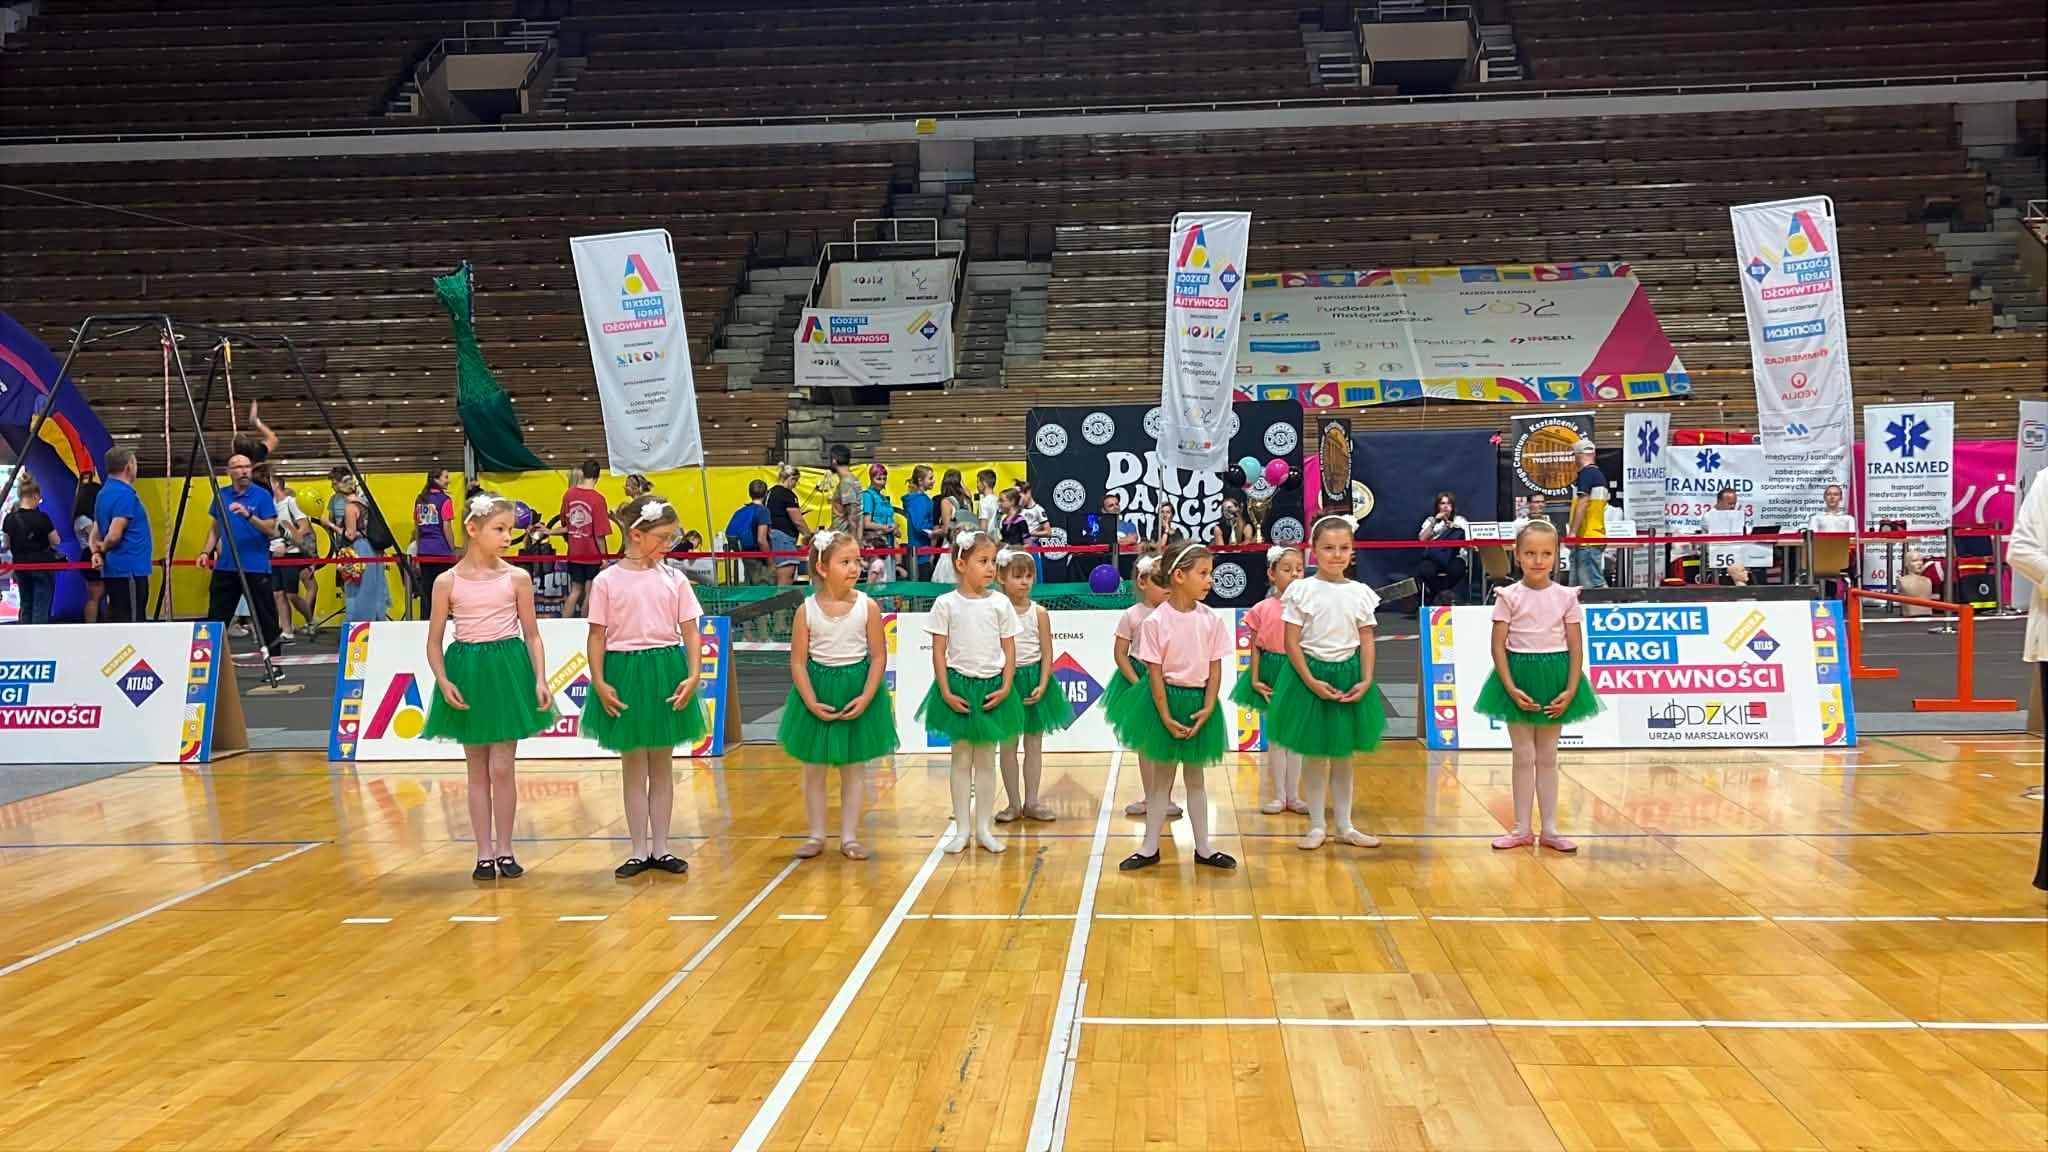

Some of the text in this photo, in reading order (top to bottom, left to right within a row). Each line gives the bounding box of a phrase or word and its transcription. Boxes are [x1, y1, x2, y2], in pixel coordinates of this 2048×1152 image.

[1867, 461, 1949, 474] TRANSMED
[1664, 478, 1753, 493] TRANSMED
[1891, 483, 1925, 492] transport
[1913, 490, 1947, 498] sanitarny
[1878, 504, 1937, 513] zabezpieczenia
[1716, 554, 1735, 567] 56
[1591, 607, 1703, 632] ŁÓDZKIE
[1051, 632, 1084, 640] ECENAS
[1591, 641, 1671, 662] TARGI
[1596, 661, 1777, 689] AKTYWNOŚCI
[126, 676, 154, 691] ATLAS
[571, 686, 587, 697] ATLA
[1648, 731, 1769, 742] URZĄD MARSZAŁKOWSKI
